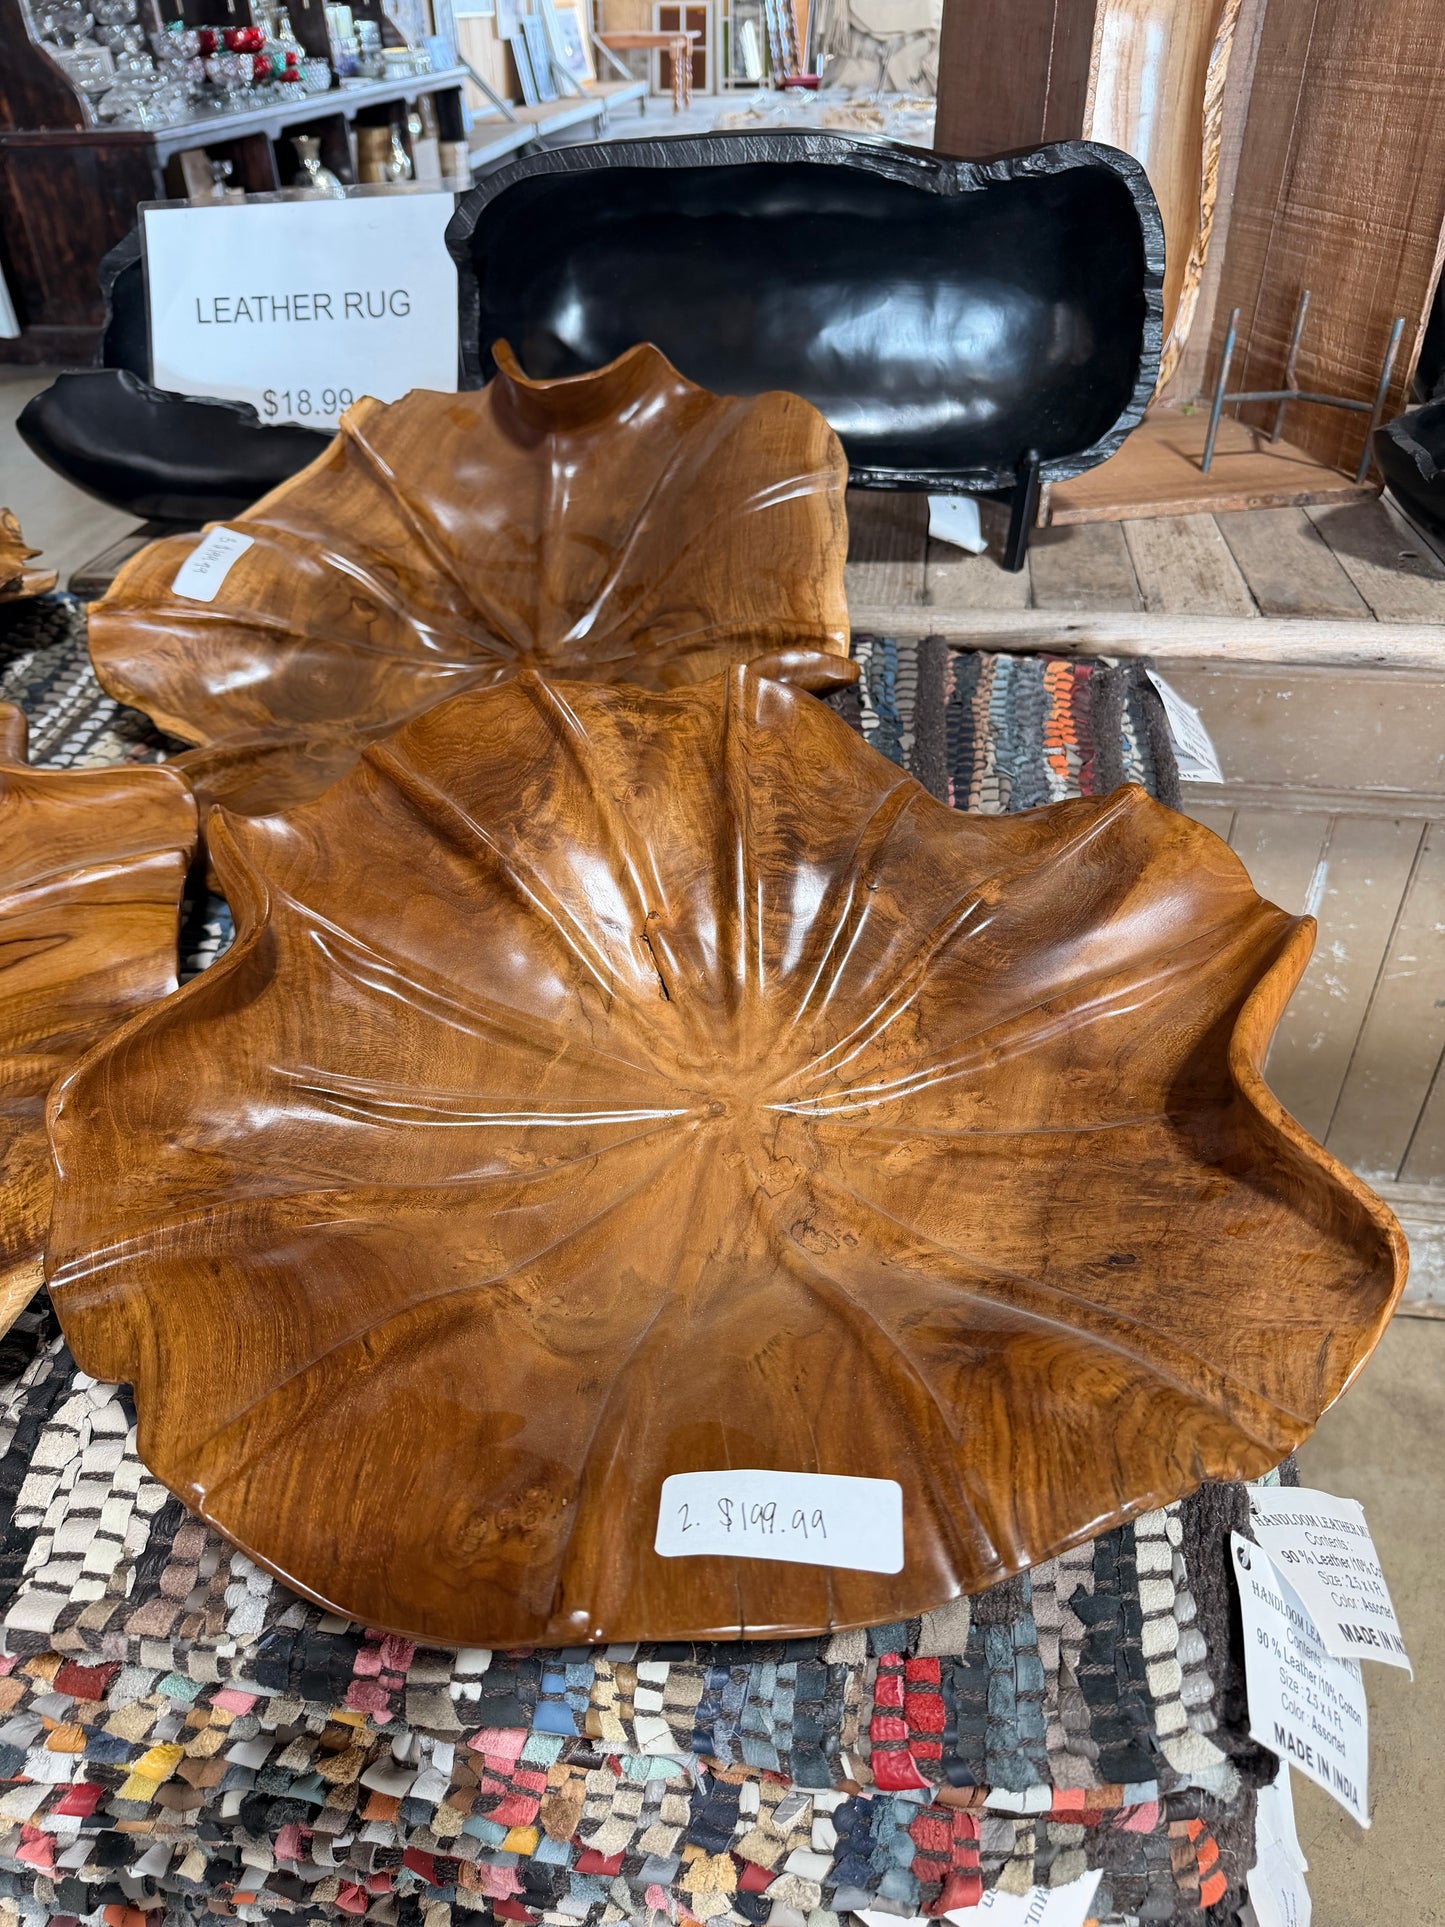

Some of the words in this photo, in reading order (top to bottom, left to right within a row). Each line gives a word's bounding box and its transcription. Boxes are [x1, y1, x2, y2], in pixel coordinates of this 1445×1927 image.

[196, 293, 334, 324] LEATHER
[345, 289, 411, 320] RUG
[263, 388, 354, 418] $18.99
[717, 1497, 827, 1539] $199.99
[1252, 1512, 1320, 1528] HANDLOOM
[1317, 1516, 1360, 1536] LEATHER
[1304, 1531, 1349, 1551] Contents
[1281, 1550, 1300, 1564] 90
[1311, 1551, 1350, 1569] Leather
[1317, 1570, 1341, 1586] Size
[1251, 1580, 1304, 1631] HANDLOOM
[1331, 1592, 1357, 1608] Color
[1361, 1597, 1394, 1620] Assorted
[1286, 1627, 1322, 1669] Contents
[1338, 1623, 1381, 1647] MADE
[1377, 1629, 1394, 1651] IN
[1257, 1628, 1269, 1649] 90
[1283, 1646, 1317, 1686] Leather
[1338, 1693, 1362, 1727] Cotton
[1279, 1667, 1299, 1694] Size
[1281, 1692, 1305, 1722] Color
[1311, 1715, 1346, 1757] Assorted
[1274, 1721, 1314, 1768] MADE
[1316, 1753, 1331, 1782] IN
[1332, 1766, 1360, 1811] INDIA
